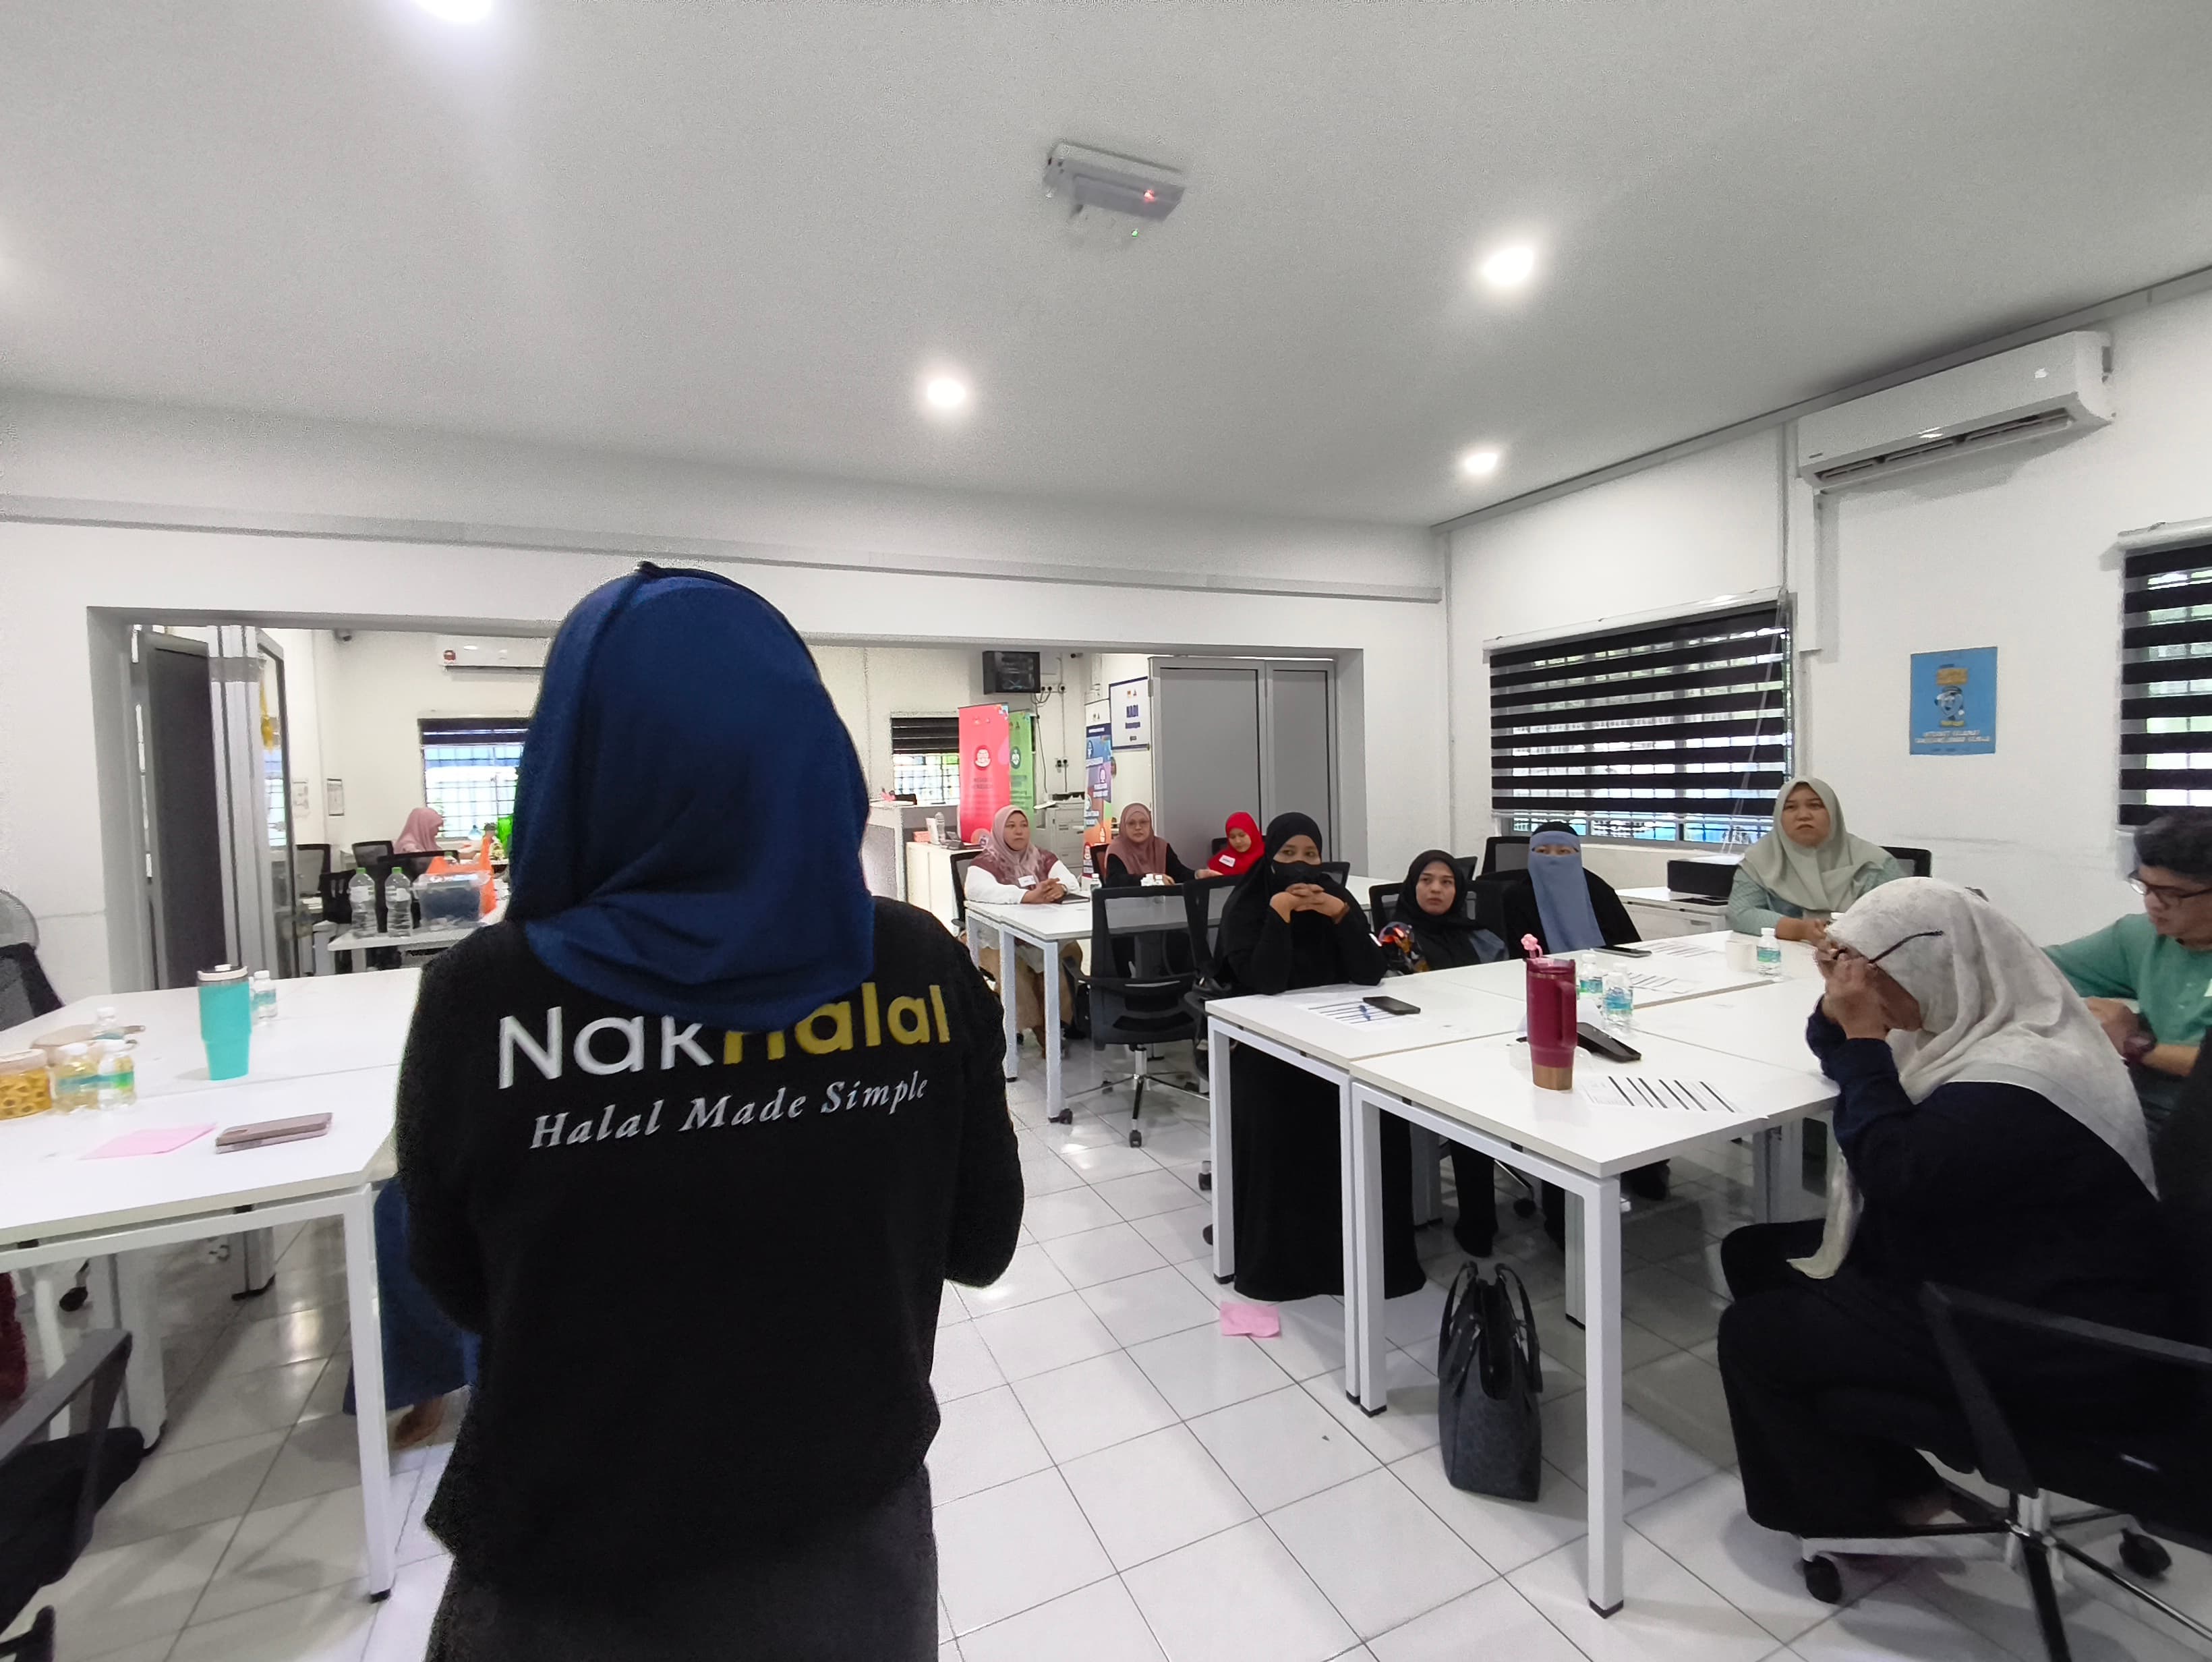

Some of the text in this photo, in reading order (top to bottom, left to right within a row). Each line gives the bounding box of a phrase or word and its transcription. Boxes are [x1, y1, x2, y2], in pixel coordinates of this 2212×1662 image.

[529, 1070, 929, 1149] Halal Made Simple
